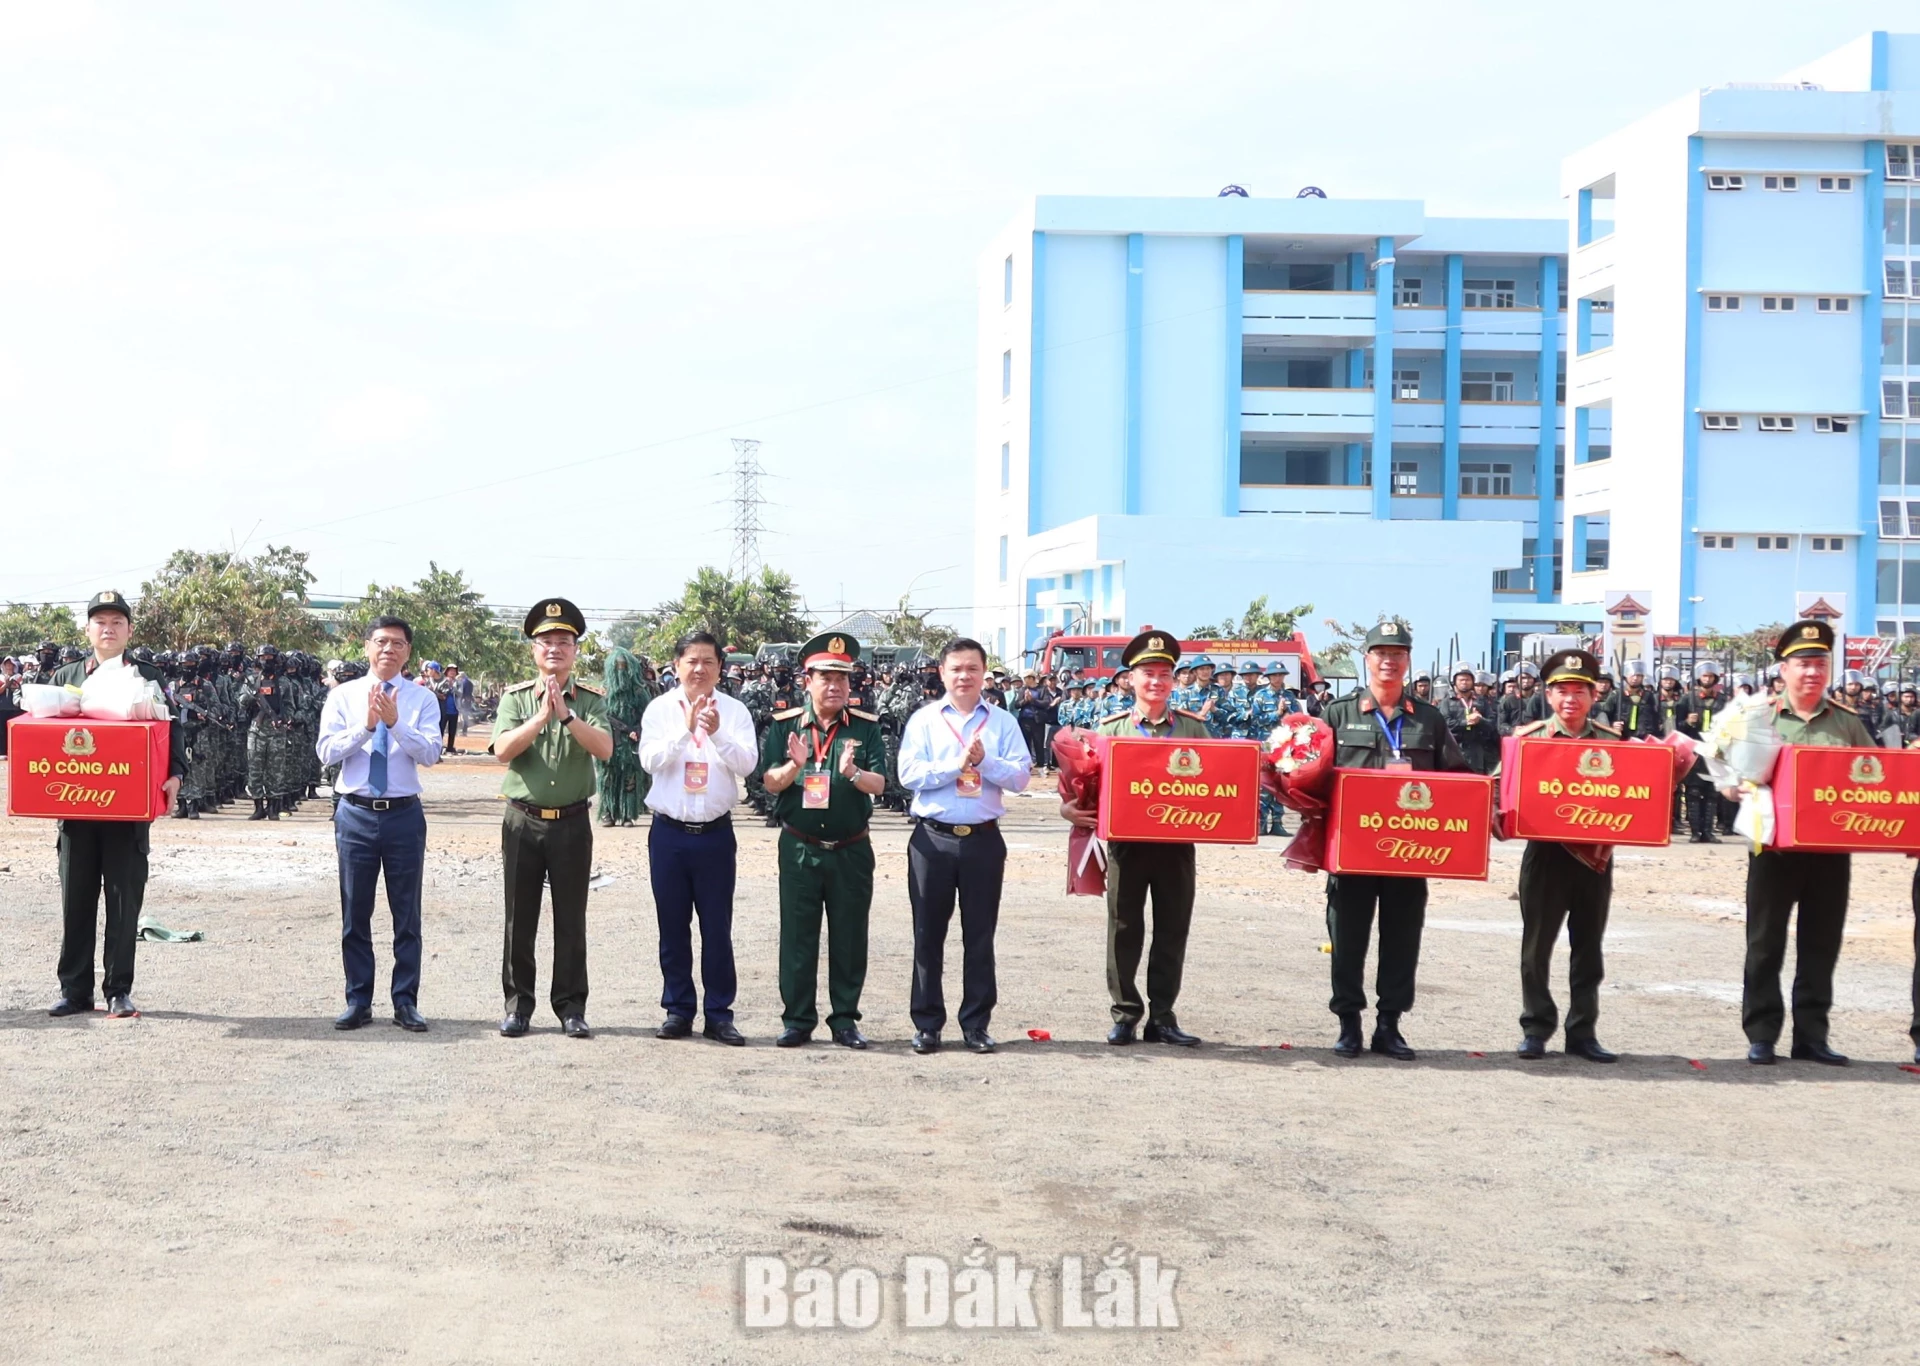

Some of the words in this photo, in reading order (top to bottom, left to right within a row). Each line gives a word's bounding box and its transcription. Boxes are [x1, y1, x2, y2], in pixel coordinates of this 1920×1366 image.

[28, 758, 50, 777] BỘ
[55, 758, 103, 775] CÔNG
[107, 763, 130, 775] AN
[45, 781, 116, 808] Tặng
[1130, 778, 1154, 799] BỘ
[1158, 779, 1210, 797] CÔNG
[1213, 784, 1238, 797] AN
[1539, 778, 1563, 798] BỘ
[1567, 780, 1621, 798] CÔNG
[1625, 786, 1650, 800] AN
[1814, 785, 1838, 806] BỘ
[1841, 786, 1893, 804] CÔNG
[1896, 791, 1920, 804] AN
[1146, 803, 1222, 831] Tặng
[1359, 812, 1384, 832] BỘ
[1388, 813, 1440, 831] CÔNG
[1443, 818, 1468, 832] AN
[1555, 803, 1633, 833] Tặng
[1830, 810, 1906, 838] Tặng
[1376, 837, 1452, 866] Tặng
